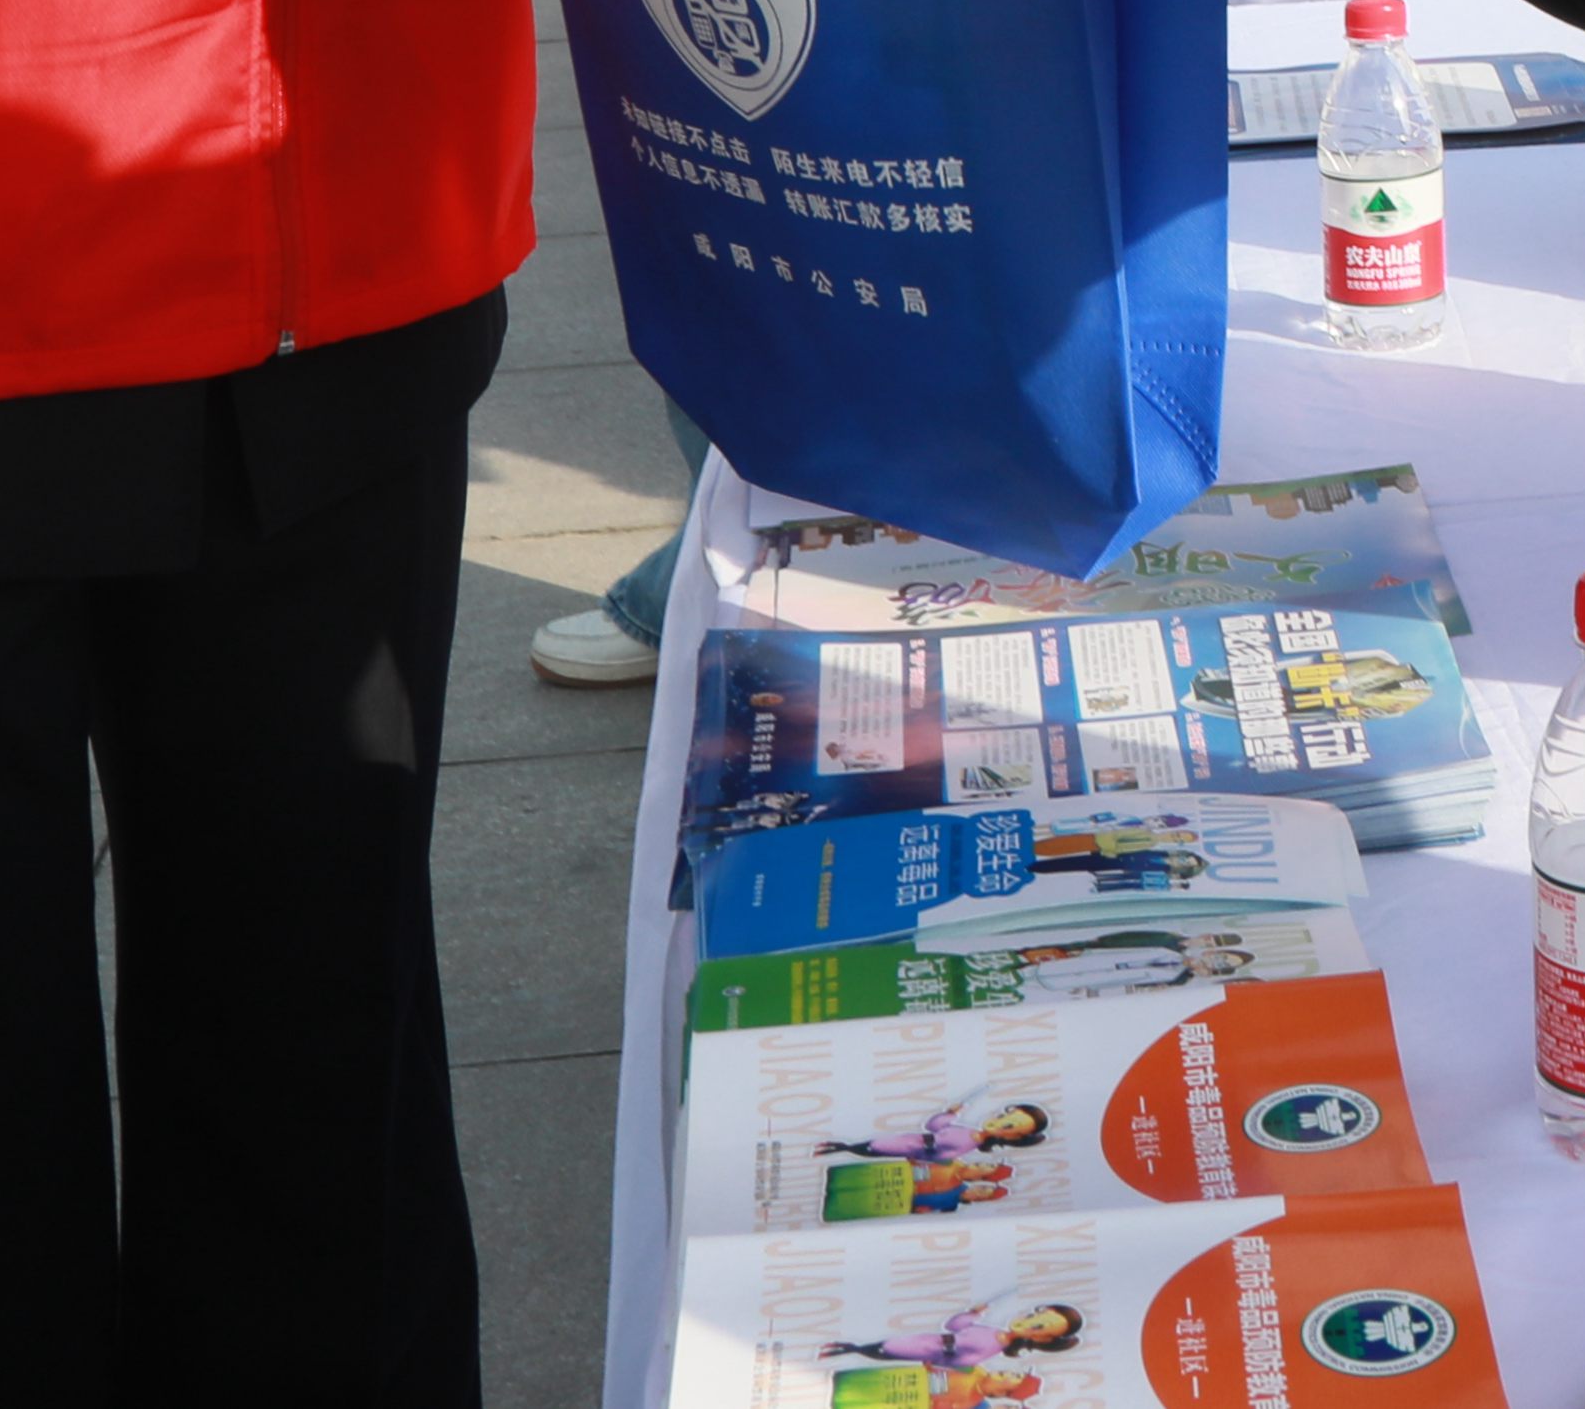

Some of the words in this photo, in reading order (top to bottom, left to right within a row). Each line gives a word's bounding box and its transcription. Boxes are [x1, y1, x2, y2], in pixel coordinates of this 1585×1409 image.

[620, 96, 752, 166] 未知链接不点击
[769, 146, 966, 190] 陌生来电不轻信
[783, 188, 975, 235] 转账汇款多核实
[693, 231, 930, 318] 咸阳市公安局
[1345, 242, 1422, 267] 农夫山泉
[895, 825, 941, 908] 远离毒品
[972, 812, 1026, 897] 珍爱生命
